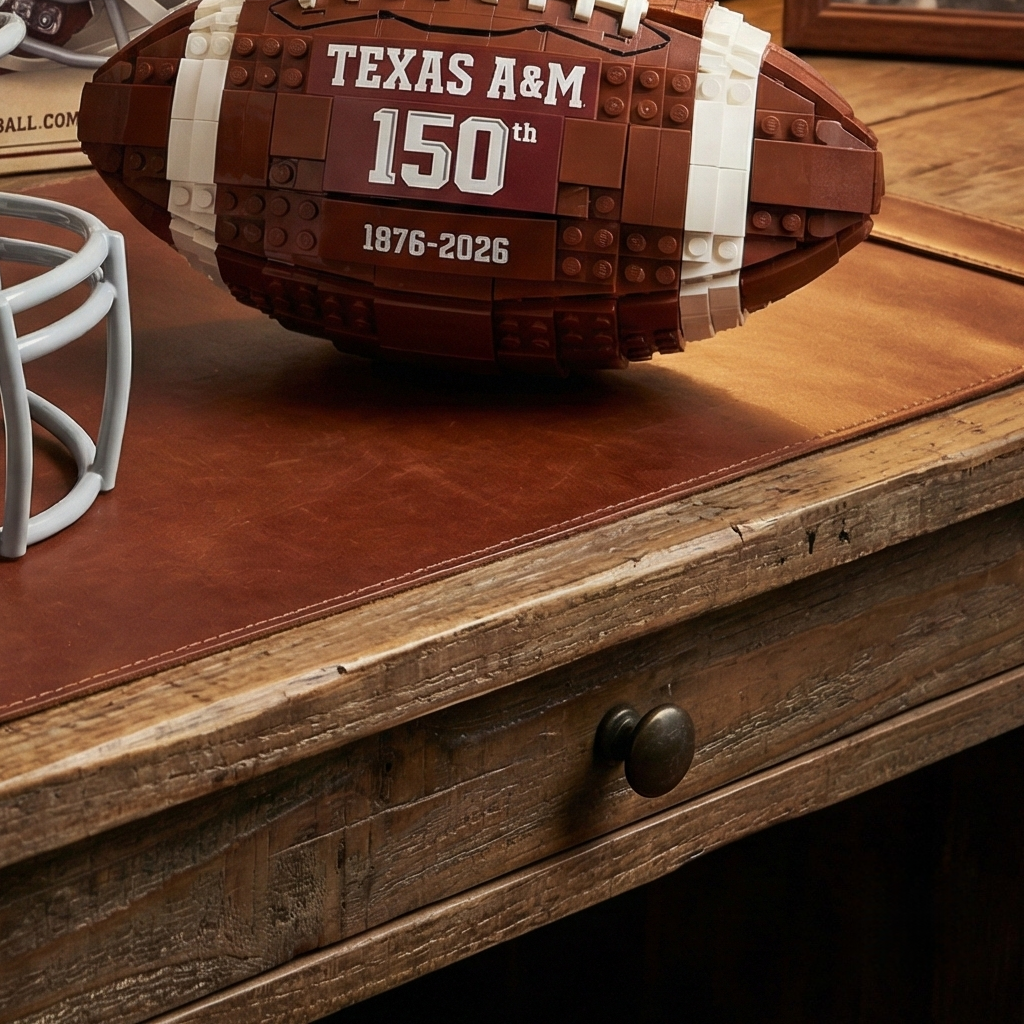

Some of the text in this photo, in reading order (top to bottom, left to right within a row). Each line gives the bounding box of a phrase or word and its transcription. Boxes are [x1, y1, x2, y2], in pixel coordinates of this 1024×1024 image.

[327, 43, 586, 108] TEXAS A&M
[368, 107, 538, 195] 150th
[363, 223, 510, 264] 1876-2026
